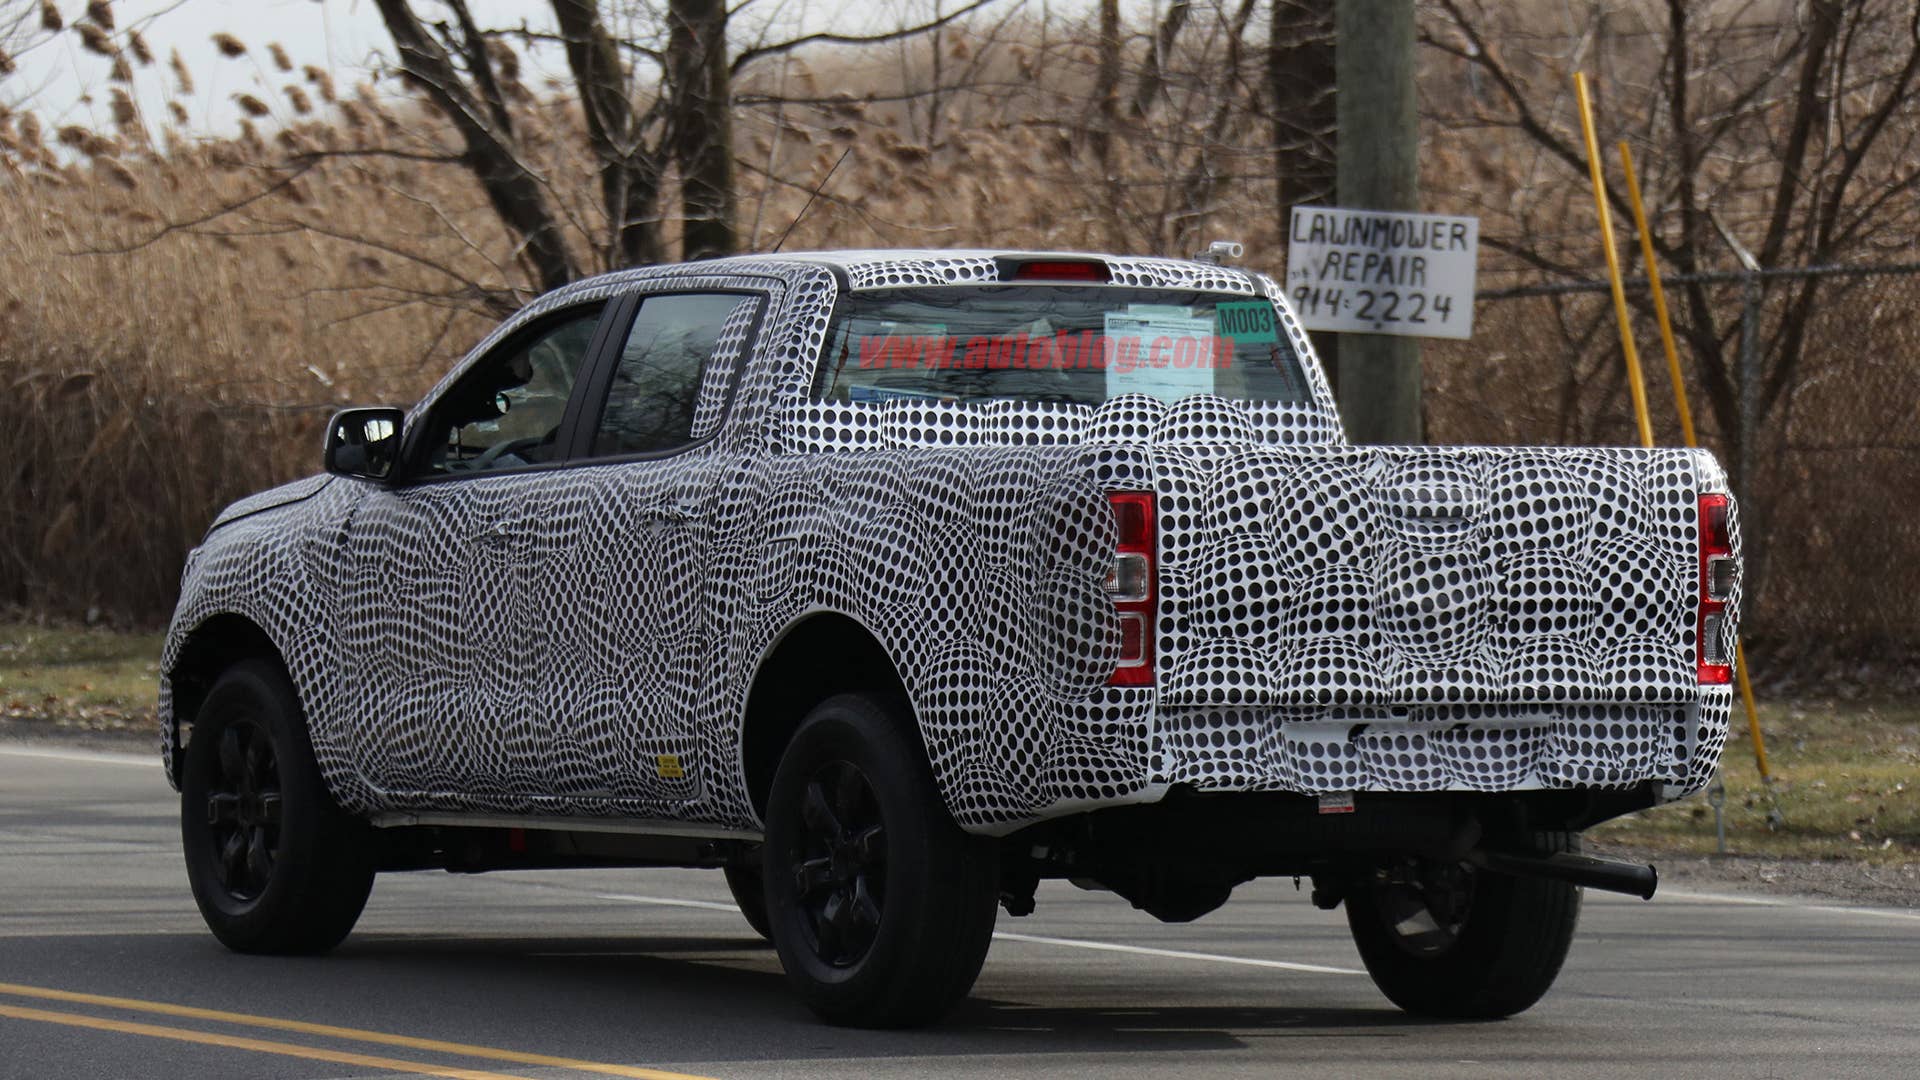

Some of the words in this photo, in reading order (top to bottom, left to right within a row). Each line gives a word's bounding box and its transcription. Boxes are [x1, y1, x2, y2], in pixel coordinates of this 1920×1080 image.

[1293, 213, 1467, 250] LAWNMOWER
[1320, 250, 1426, 288] REPAIR
[1220, 305, 1271, 334] M003
